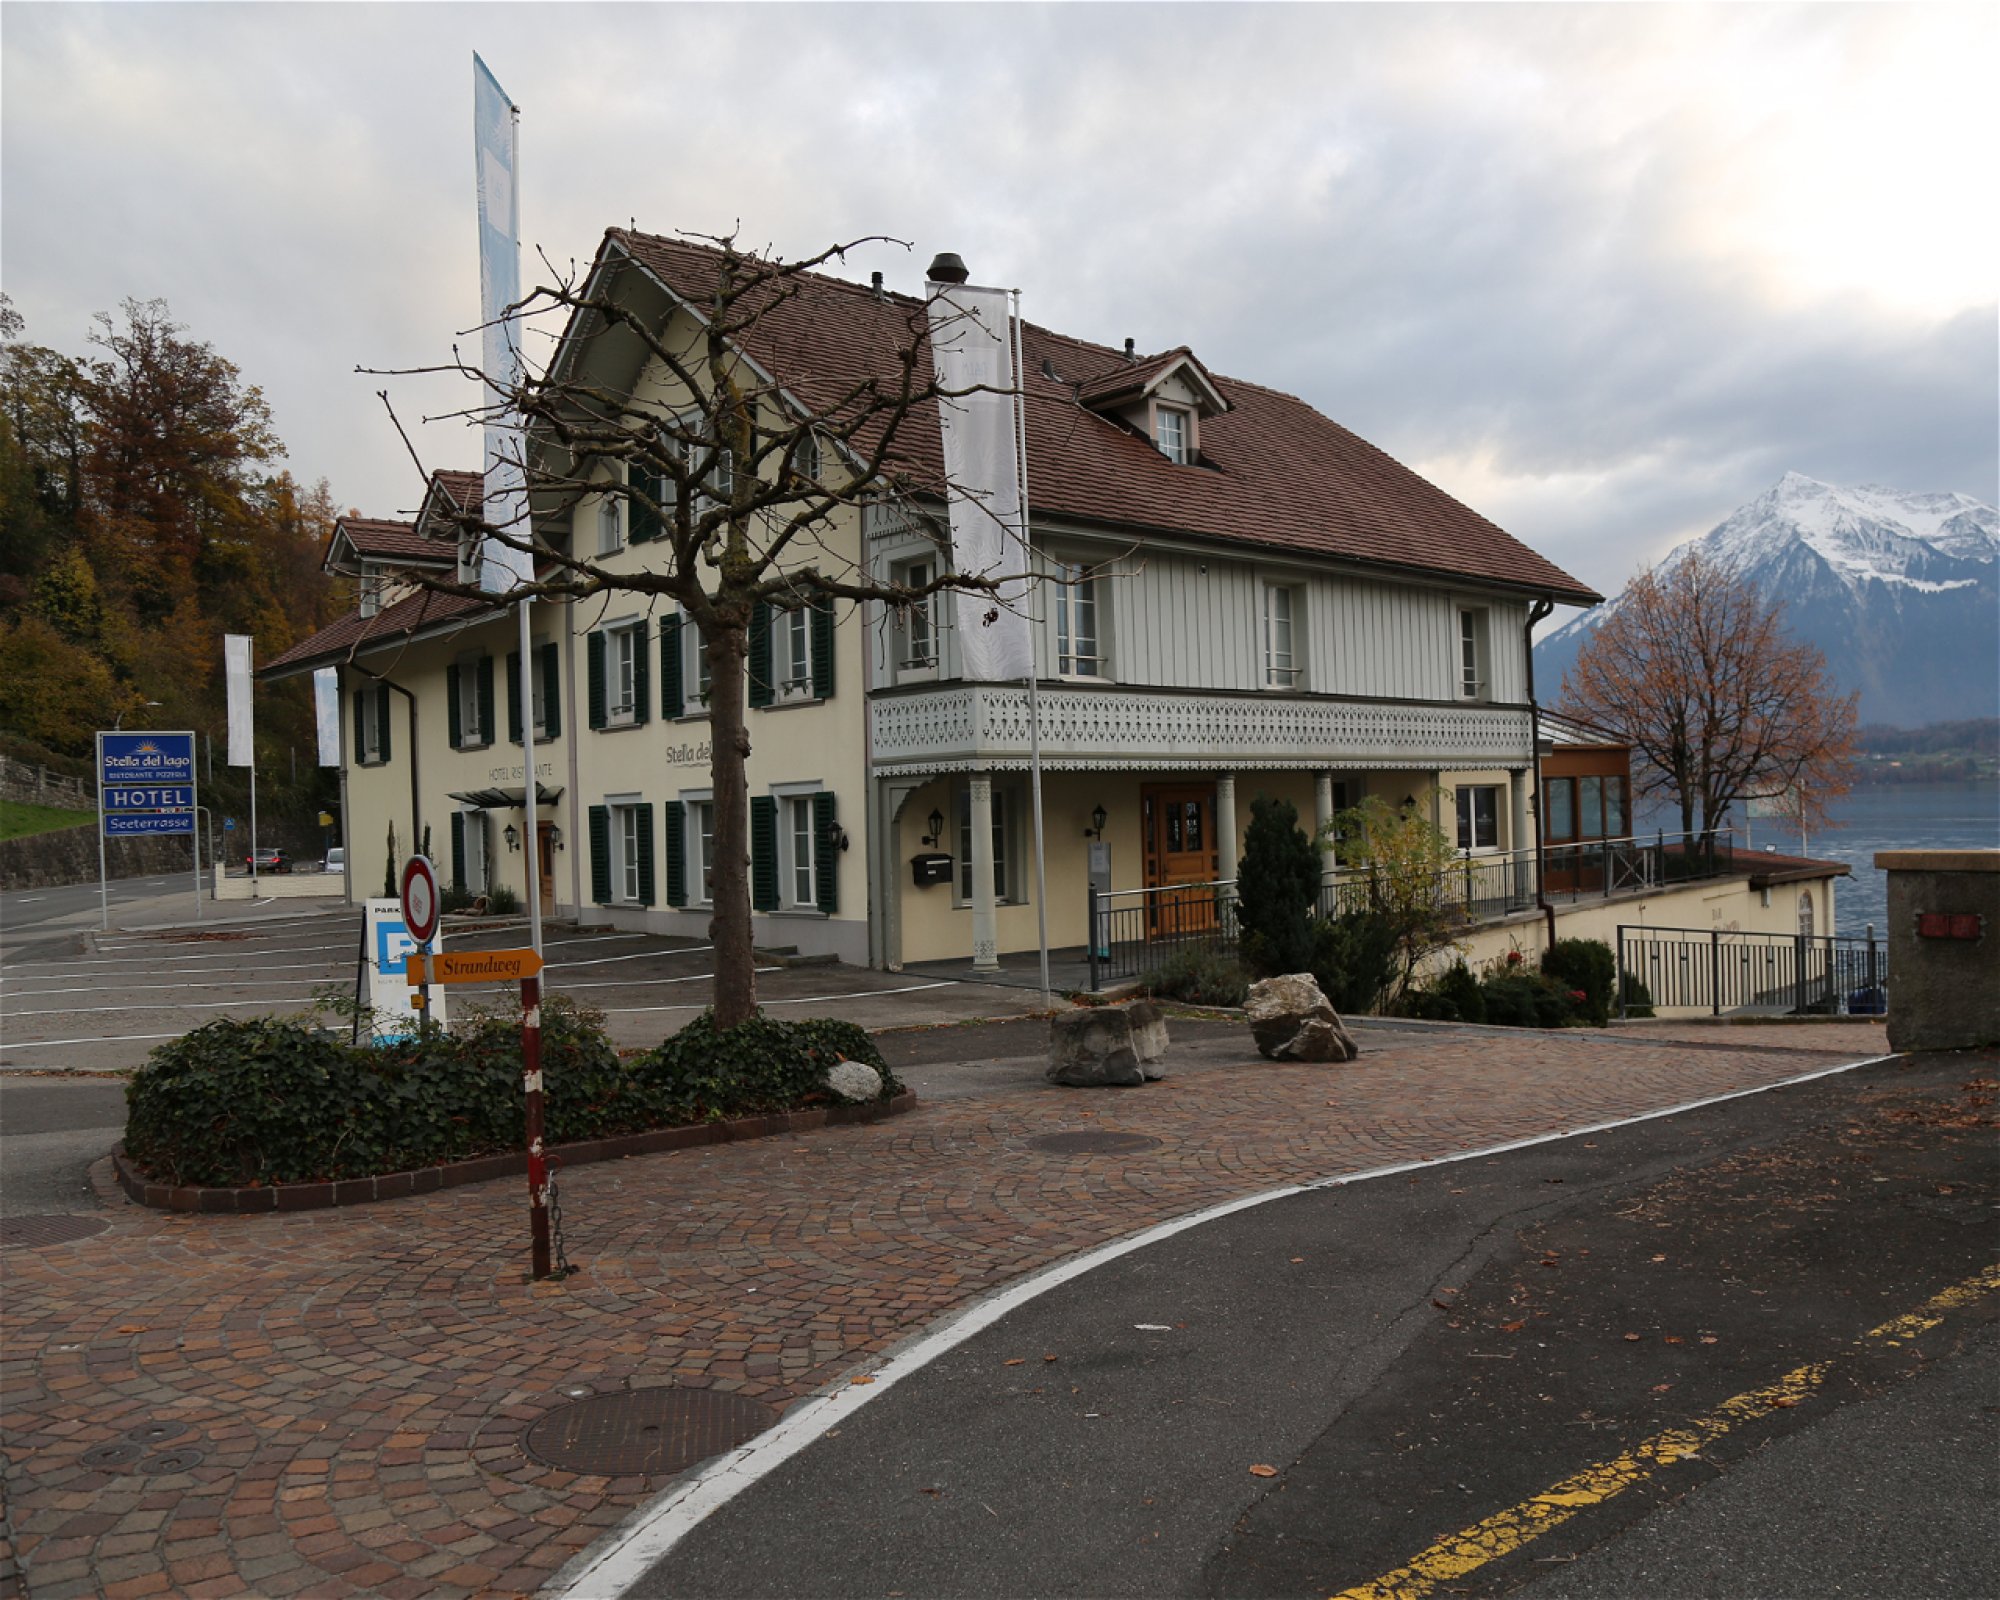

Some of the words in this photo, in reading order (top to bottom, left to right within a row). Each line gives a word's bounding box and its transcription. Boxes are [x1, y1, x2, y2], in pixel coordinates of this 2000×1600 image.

[666, 743, 695, 763] Stella
[696, 741, 713, 760] del
[105, 755, 140, 767] Stella
[142, 755, 160, 767] del
[163, 755, 190, 768] lago
[488, 767, 509, 781] HOTEL
[511, 763, 553, 779] RISTANTE
[113, 790, 187, 806] HOTEL
[110, 818, 189, 829] Seeterrasse
[442, 955, 522, 977] Strandweg
